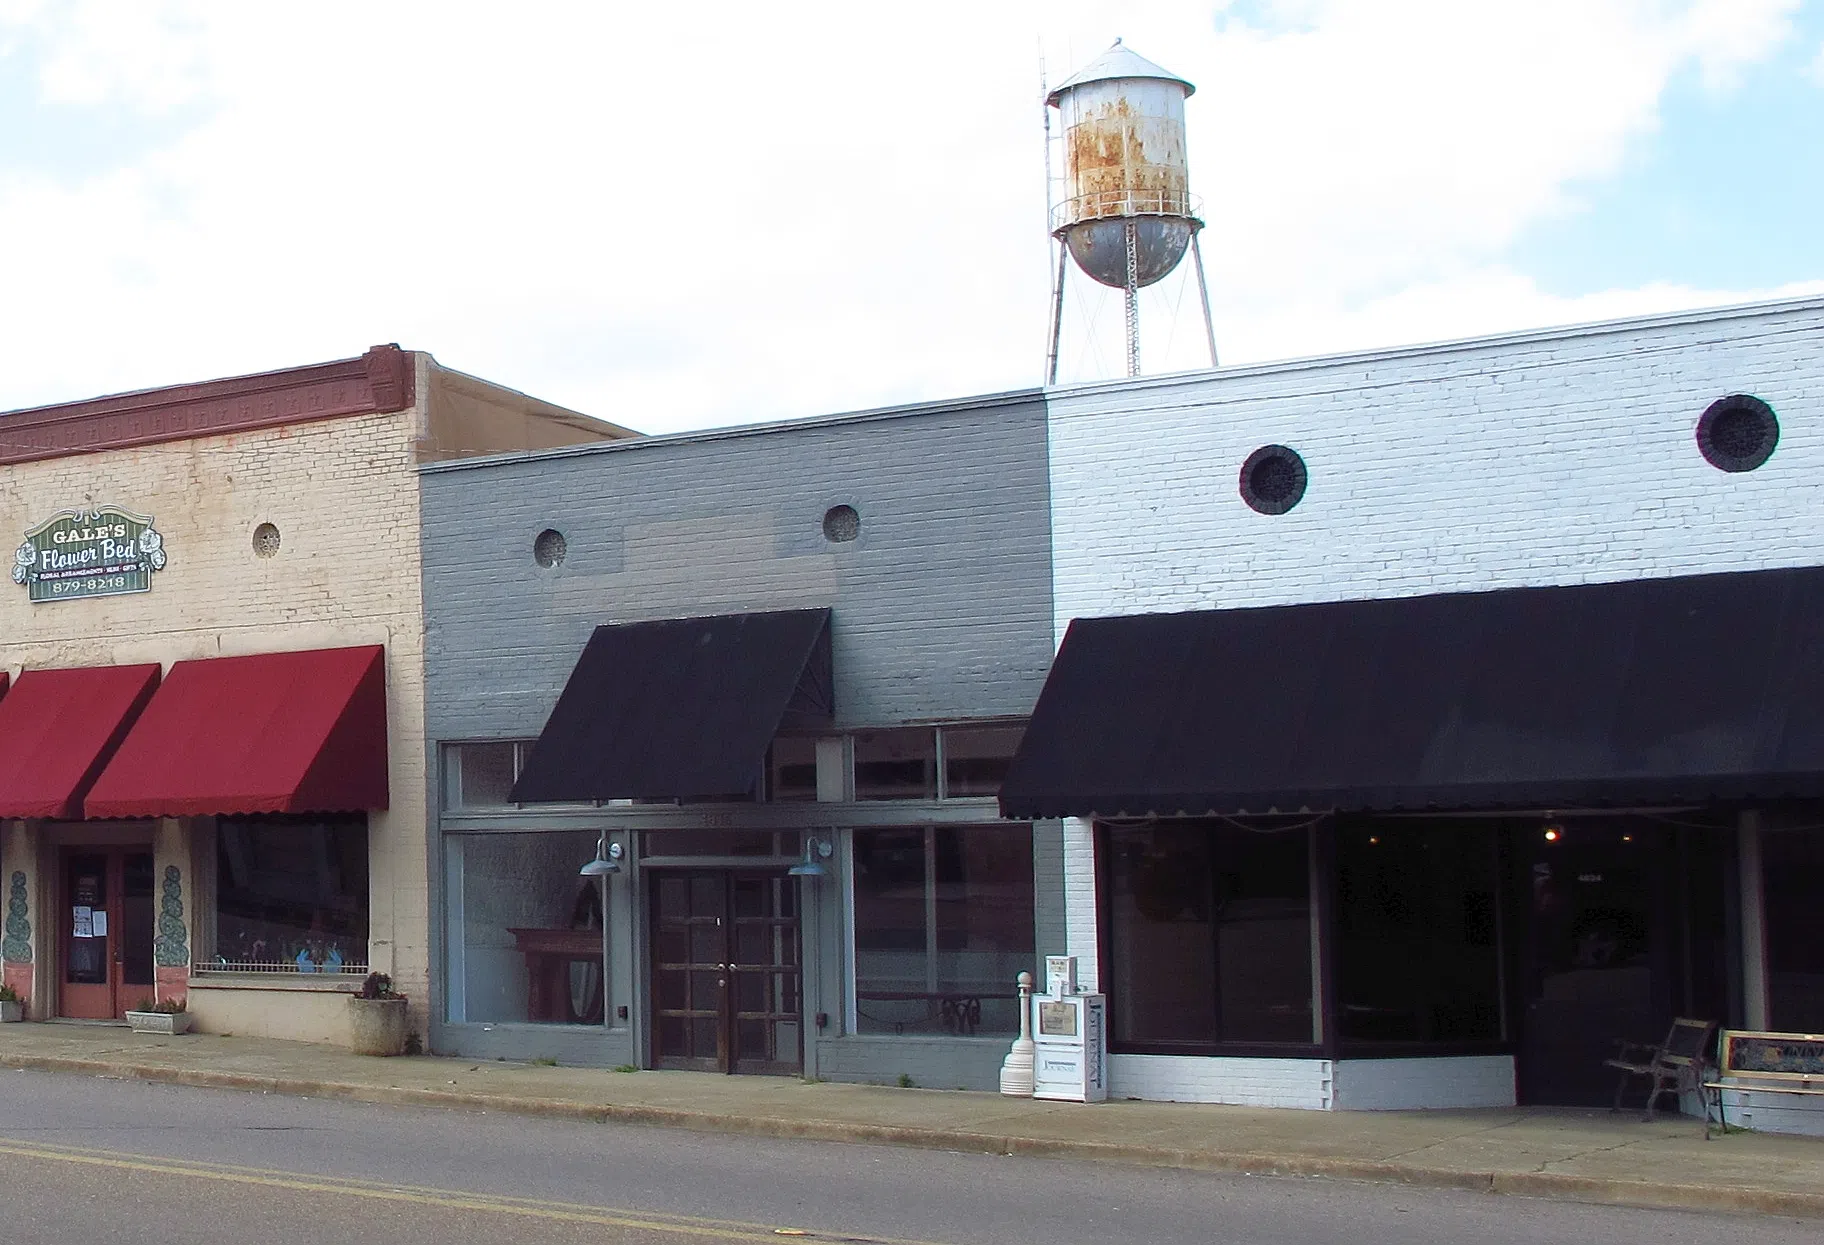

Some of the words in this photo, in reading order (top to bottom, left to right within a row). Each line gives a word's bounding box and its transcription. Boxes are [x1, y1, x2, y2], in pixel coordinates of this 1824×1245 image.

[53, 524, 126, 544] GALE'S
[41, 548, 97, 570] Flower
[100, 539, 136, 559] Bed
[53, 577, 125, 593] 879-8218
[1043, 1060, 1075, 1073] JOURNAL
